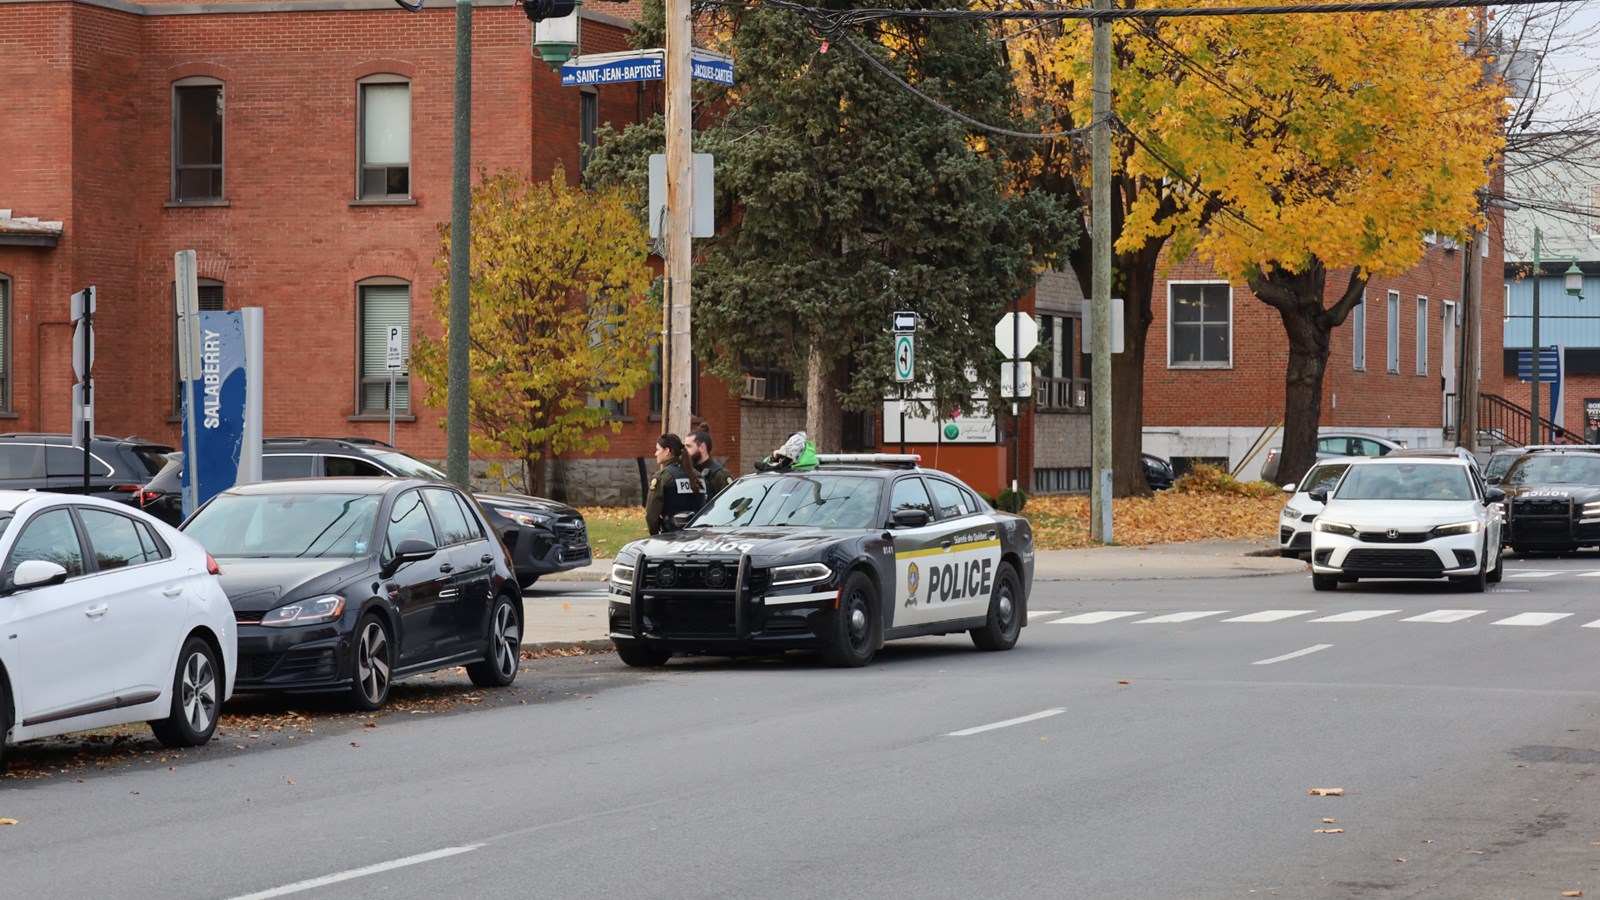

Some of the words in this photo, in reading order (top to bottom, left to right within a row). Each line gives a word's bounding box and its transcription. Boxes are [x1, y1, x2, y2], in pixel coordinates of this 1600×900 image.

[576, 64, 662, 83] SAINT-JEAN-BAPTISTE
[693, 64, 734, 84] JACQUES-CARTIER
[391, 327, 398, 341] P
[203, 329, 220, 429] SALABERRY
[926, 558, 992, 604] POLICE
